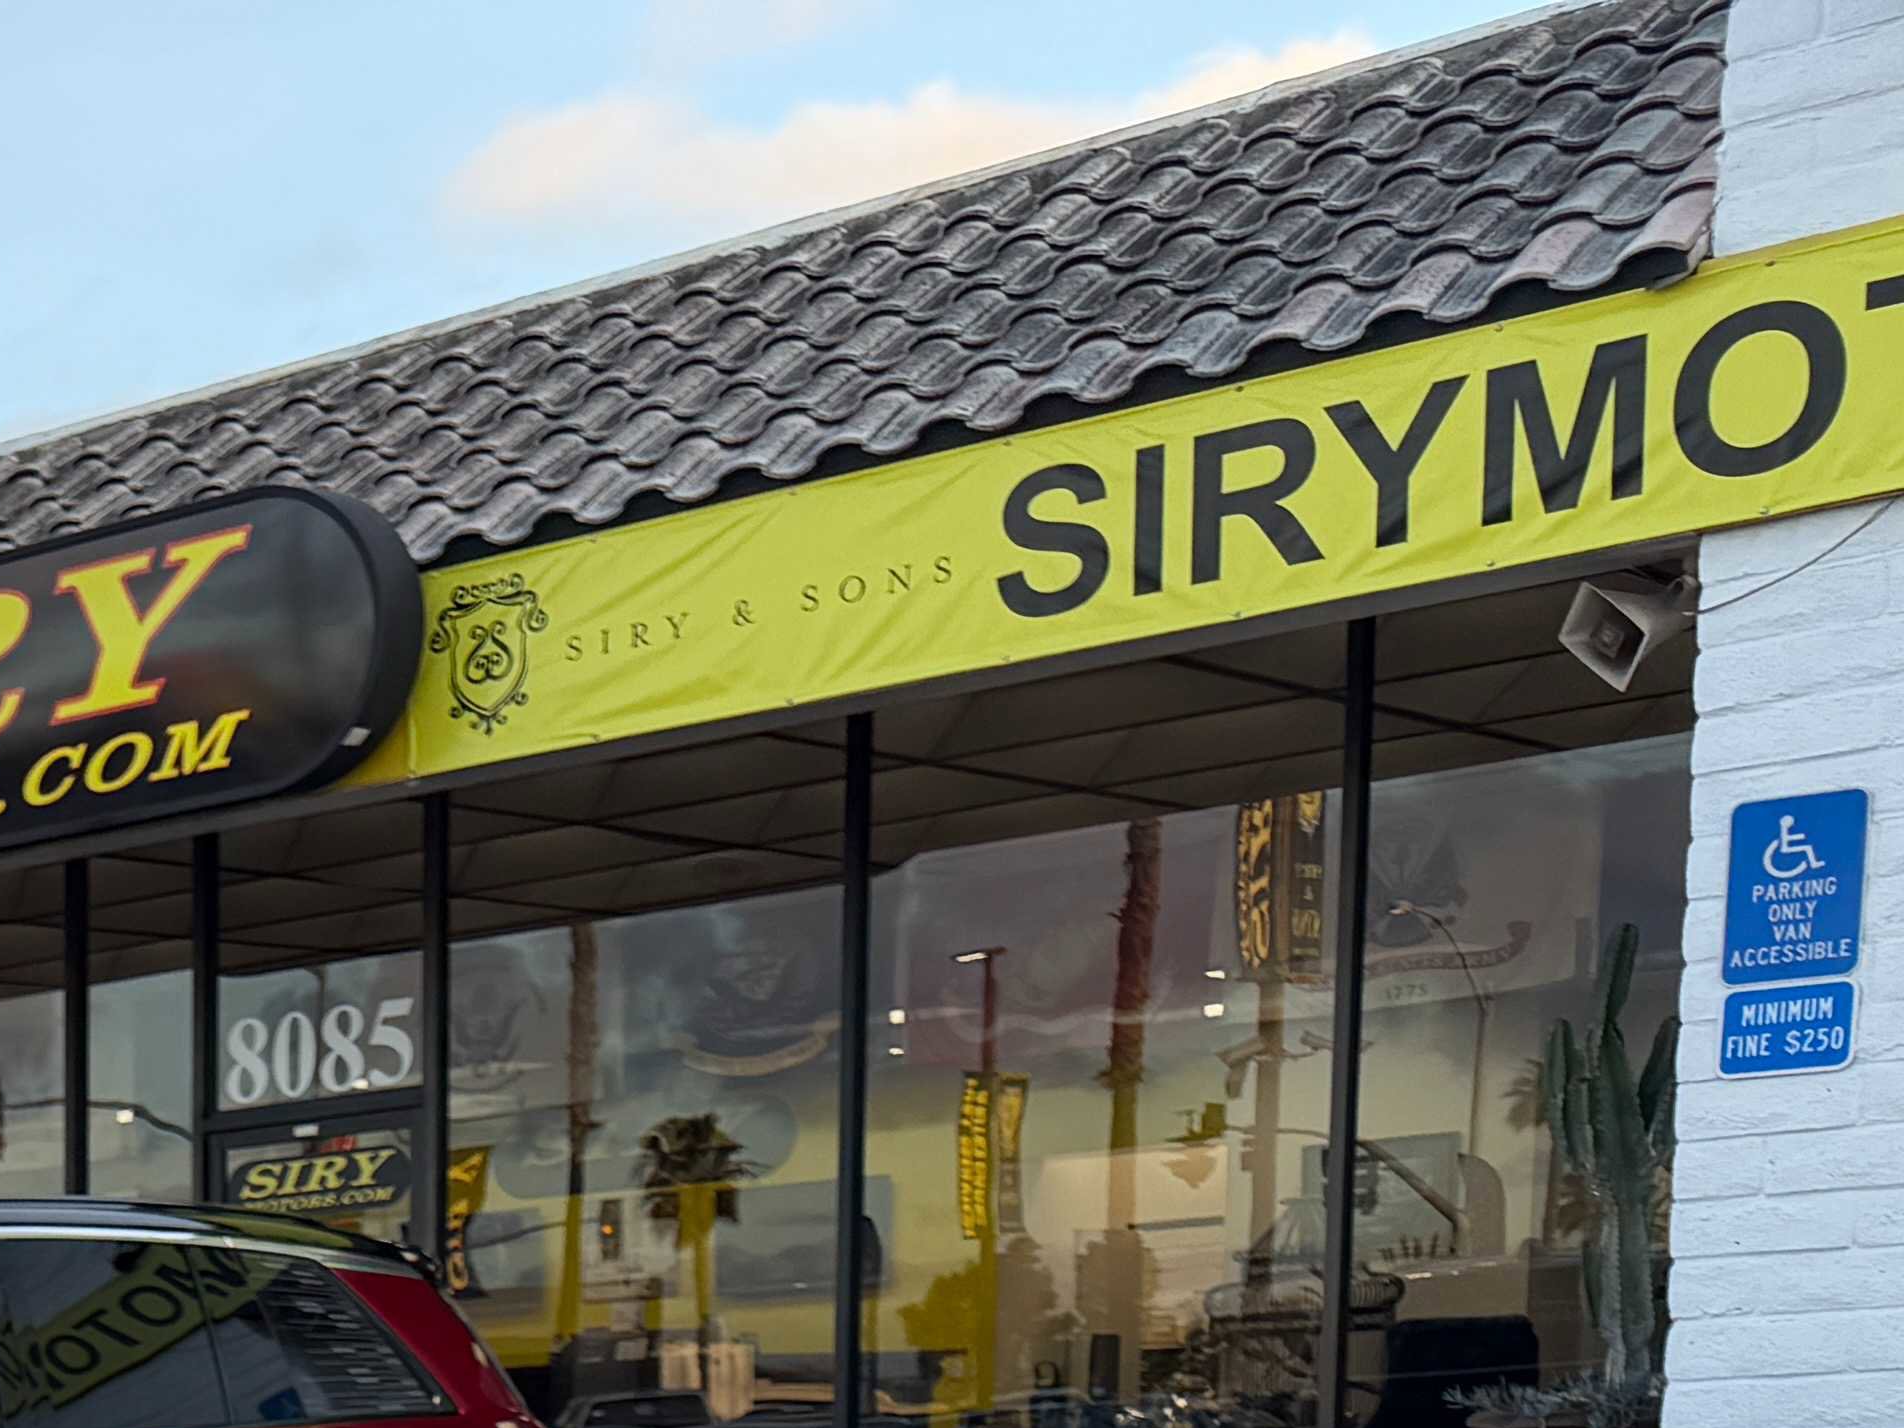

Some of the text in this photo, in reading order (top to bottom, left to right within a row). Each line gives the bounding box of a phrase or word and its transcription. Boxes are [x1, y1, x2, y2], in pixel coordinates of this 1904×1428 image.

[565, 556, 954, 662] SIRY & SONS
[1752, 877, 1838, 903] PARKING
[1768, 901, 1817, 923] ONLY
[1772, 922, 1812, 942] VAN
[1730, 939, 1852, 968] ACCESSIBLE
[1741, 997, 1834, 1027] MINIMUM
[224, 998, 414, 1104] 8085
[1726, 1026, 1844, 1059] FINE $250
[240, 1149, 397, 1200] SIRY
